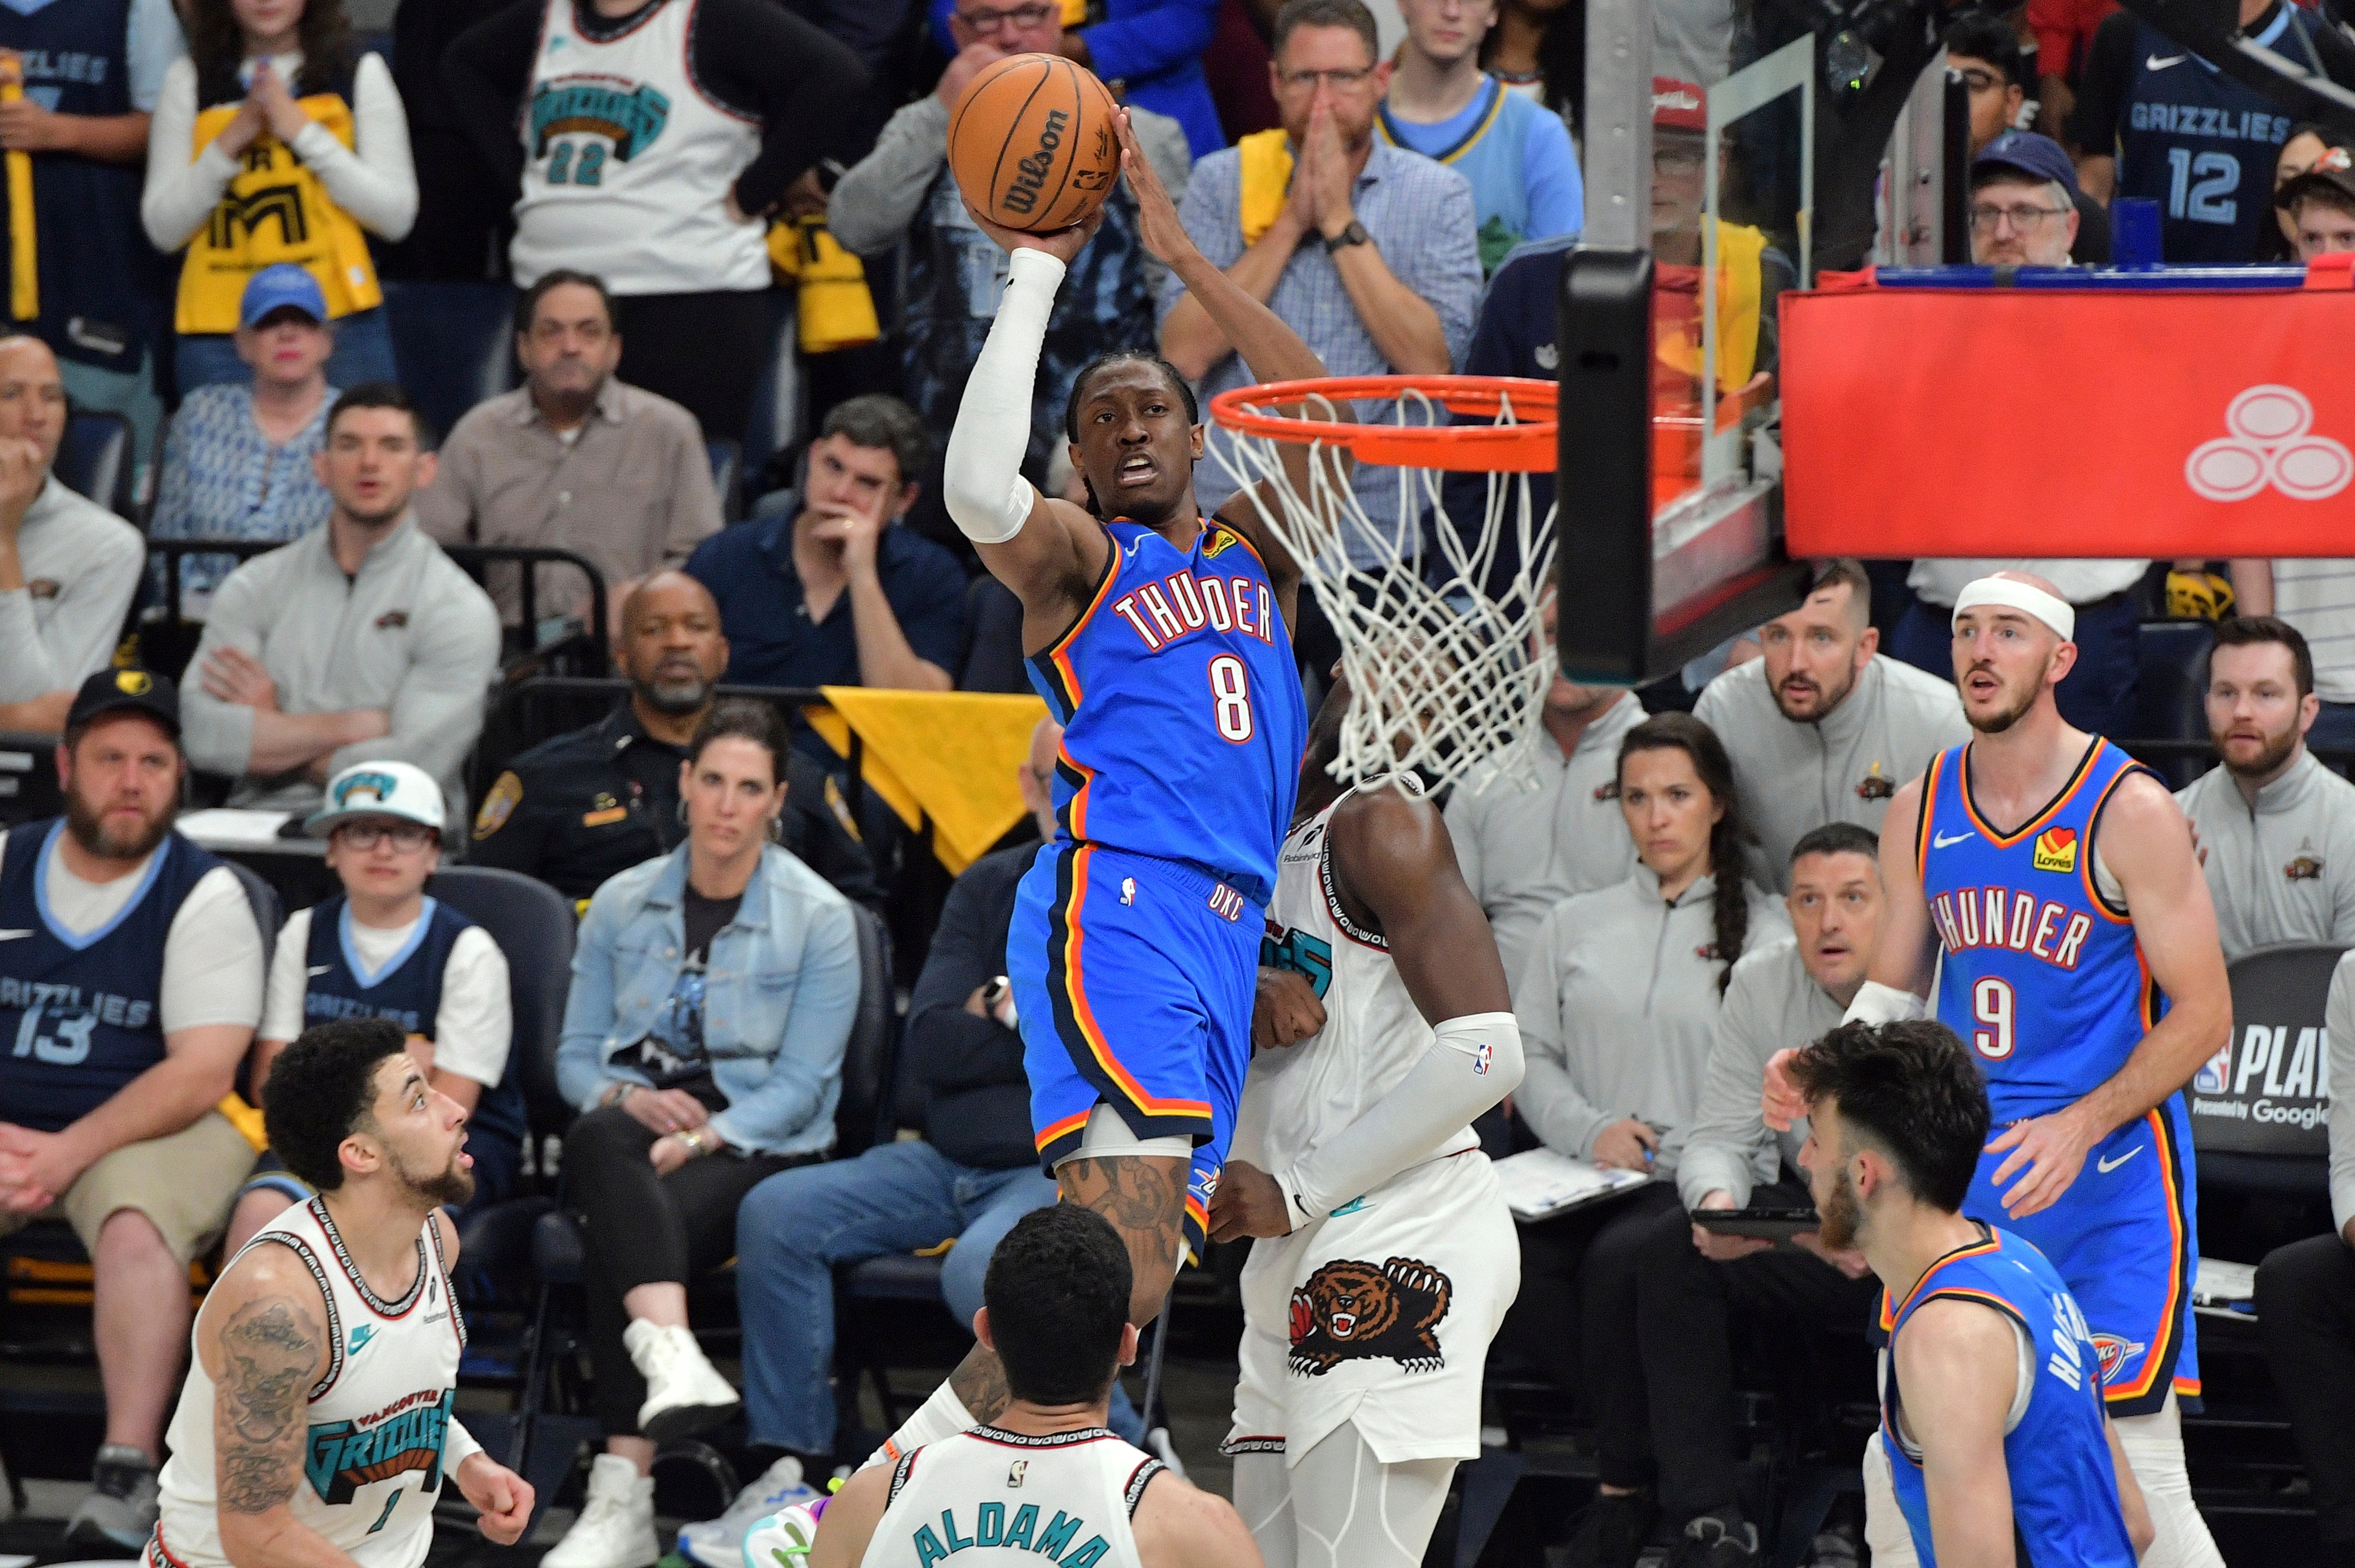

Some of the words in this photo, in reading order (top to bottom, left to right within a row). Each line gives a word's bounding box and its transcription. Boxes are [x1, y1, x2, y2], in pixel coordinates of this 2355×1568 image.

[2131, 102, 2290, 145] GRIZZLIES
[547, 141, 606, 184] 22
[1002, 109, 1069, 214] Wilson
[2168, 148, 2241, 225] 12
[1208, 652, 1255, 745] 8
[1208, 882, 1244, 923] OKC
[1971, 974, 2016, 1061] 9
[2098, 1344, 2116, 1362] KC
[358, 1389, 438, 1426] VANCOUVER
[913, 1502, 1111, 1568] ALDAMA
